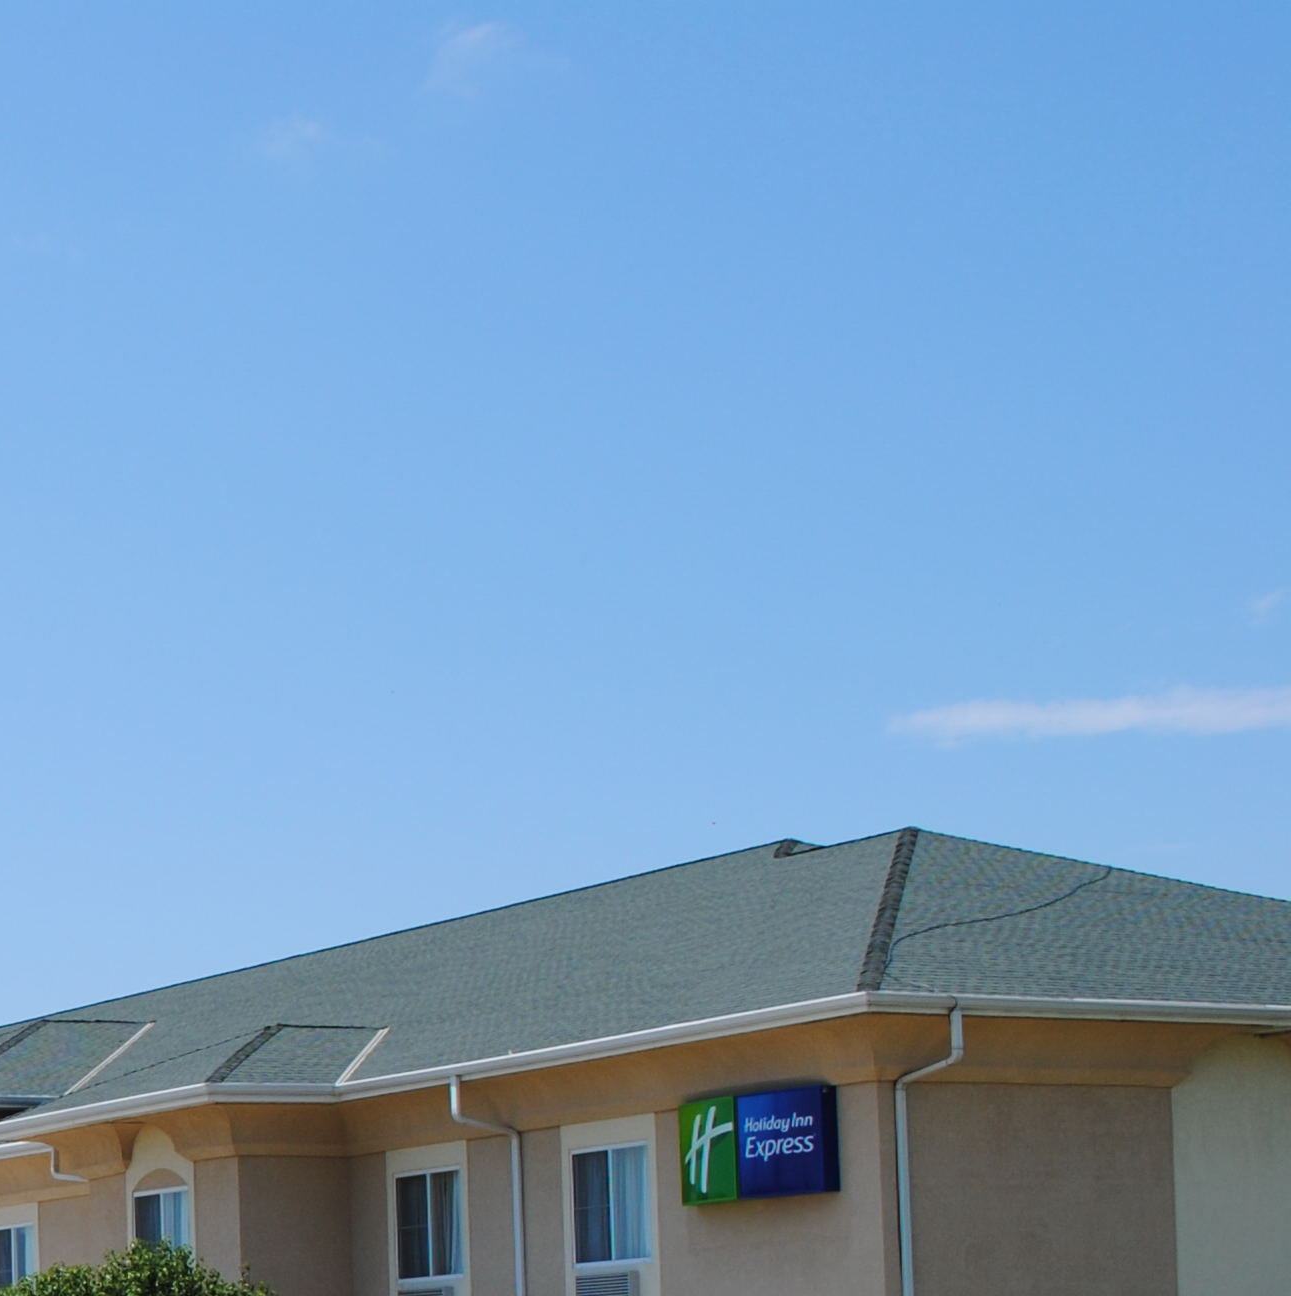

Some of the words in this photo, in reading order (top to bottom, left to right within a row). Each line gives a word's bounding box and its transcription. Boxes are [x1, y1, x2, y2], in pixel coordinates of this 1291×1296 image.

[744, 1115, 792, 1133] Holiday
[791, 1112, 814, 1128] Inn
[744, 1135, 816, 1162] Express
